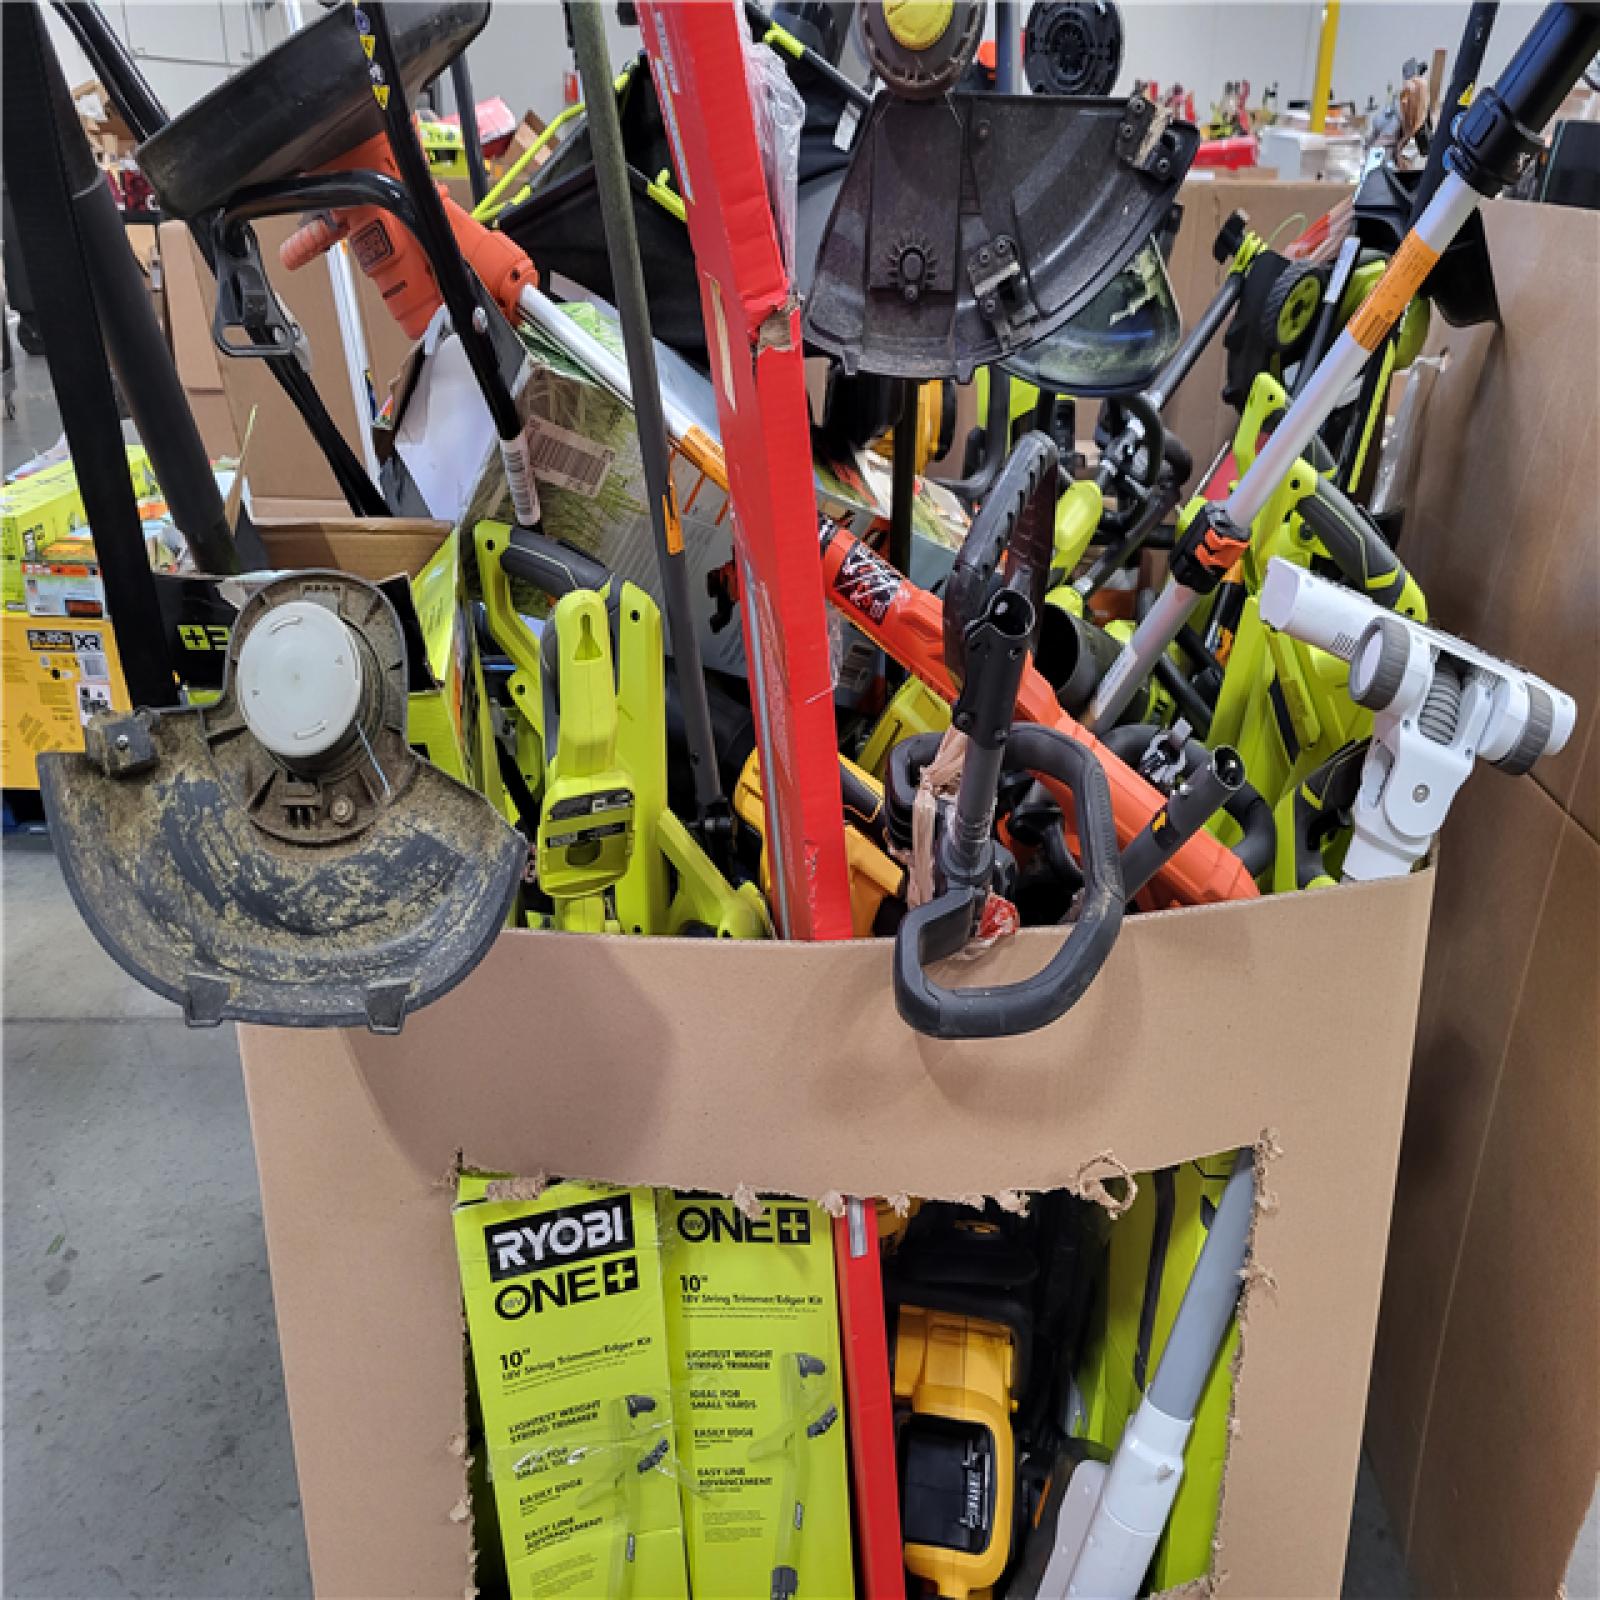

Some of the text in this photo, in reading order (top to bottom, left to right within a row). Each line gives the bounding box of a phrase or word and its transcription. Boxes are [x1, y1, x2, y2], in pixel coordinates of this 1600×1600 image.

[492, 1206, 624, 1271] RYOBI
[494, 1257, 640, 1320] ONE+
[679, 1274, 708, 1293] 10"
[701, 1294, 731, 1306] String
[808, 1295, 823, 1305] Kit
[500, 1347, 531, 1371] 10"
[685, 1349, 773, 1360] LIGHTEST WEIGHT
[687, 1361, 771, 1371] STRING TRIMMER
[689, 1389, 741, 1398] IDEAL FOR
[690, 1400, 758, 1410] SMALL YARDS
[508, 1399, 601, 1434] LIGHTEST WEIGHT
[509, 1411, 599, 1444] STRING TRIMMER
[727, 1427, 754, 1438] EDGE
[697, 1467, 746, 1476] EASY LINE
[554, 1478, 583, 1493] EDGE
[699, 1477, 773, 1486] ADVANCEMENT
